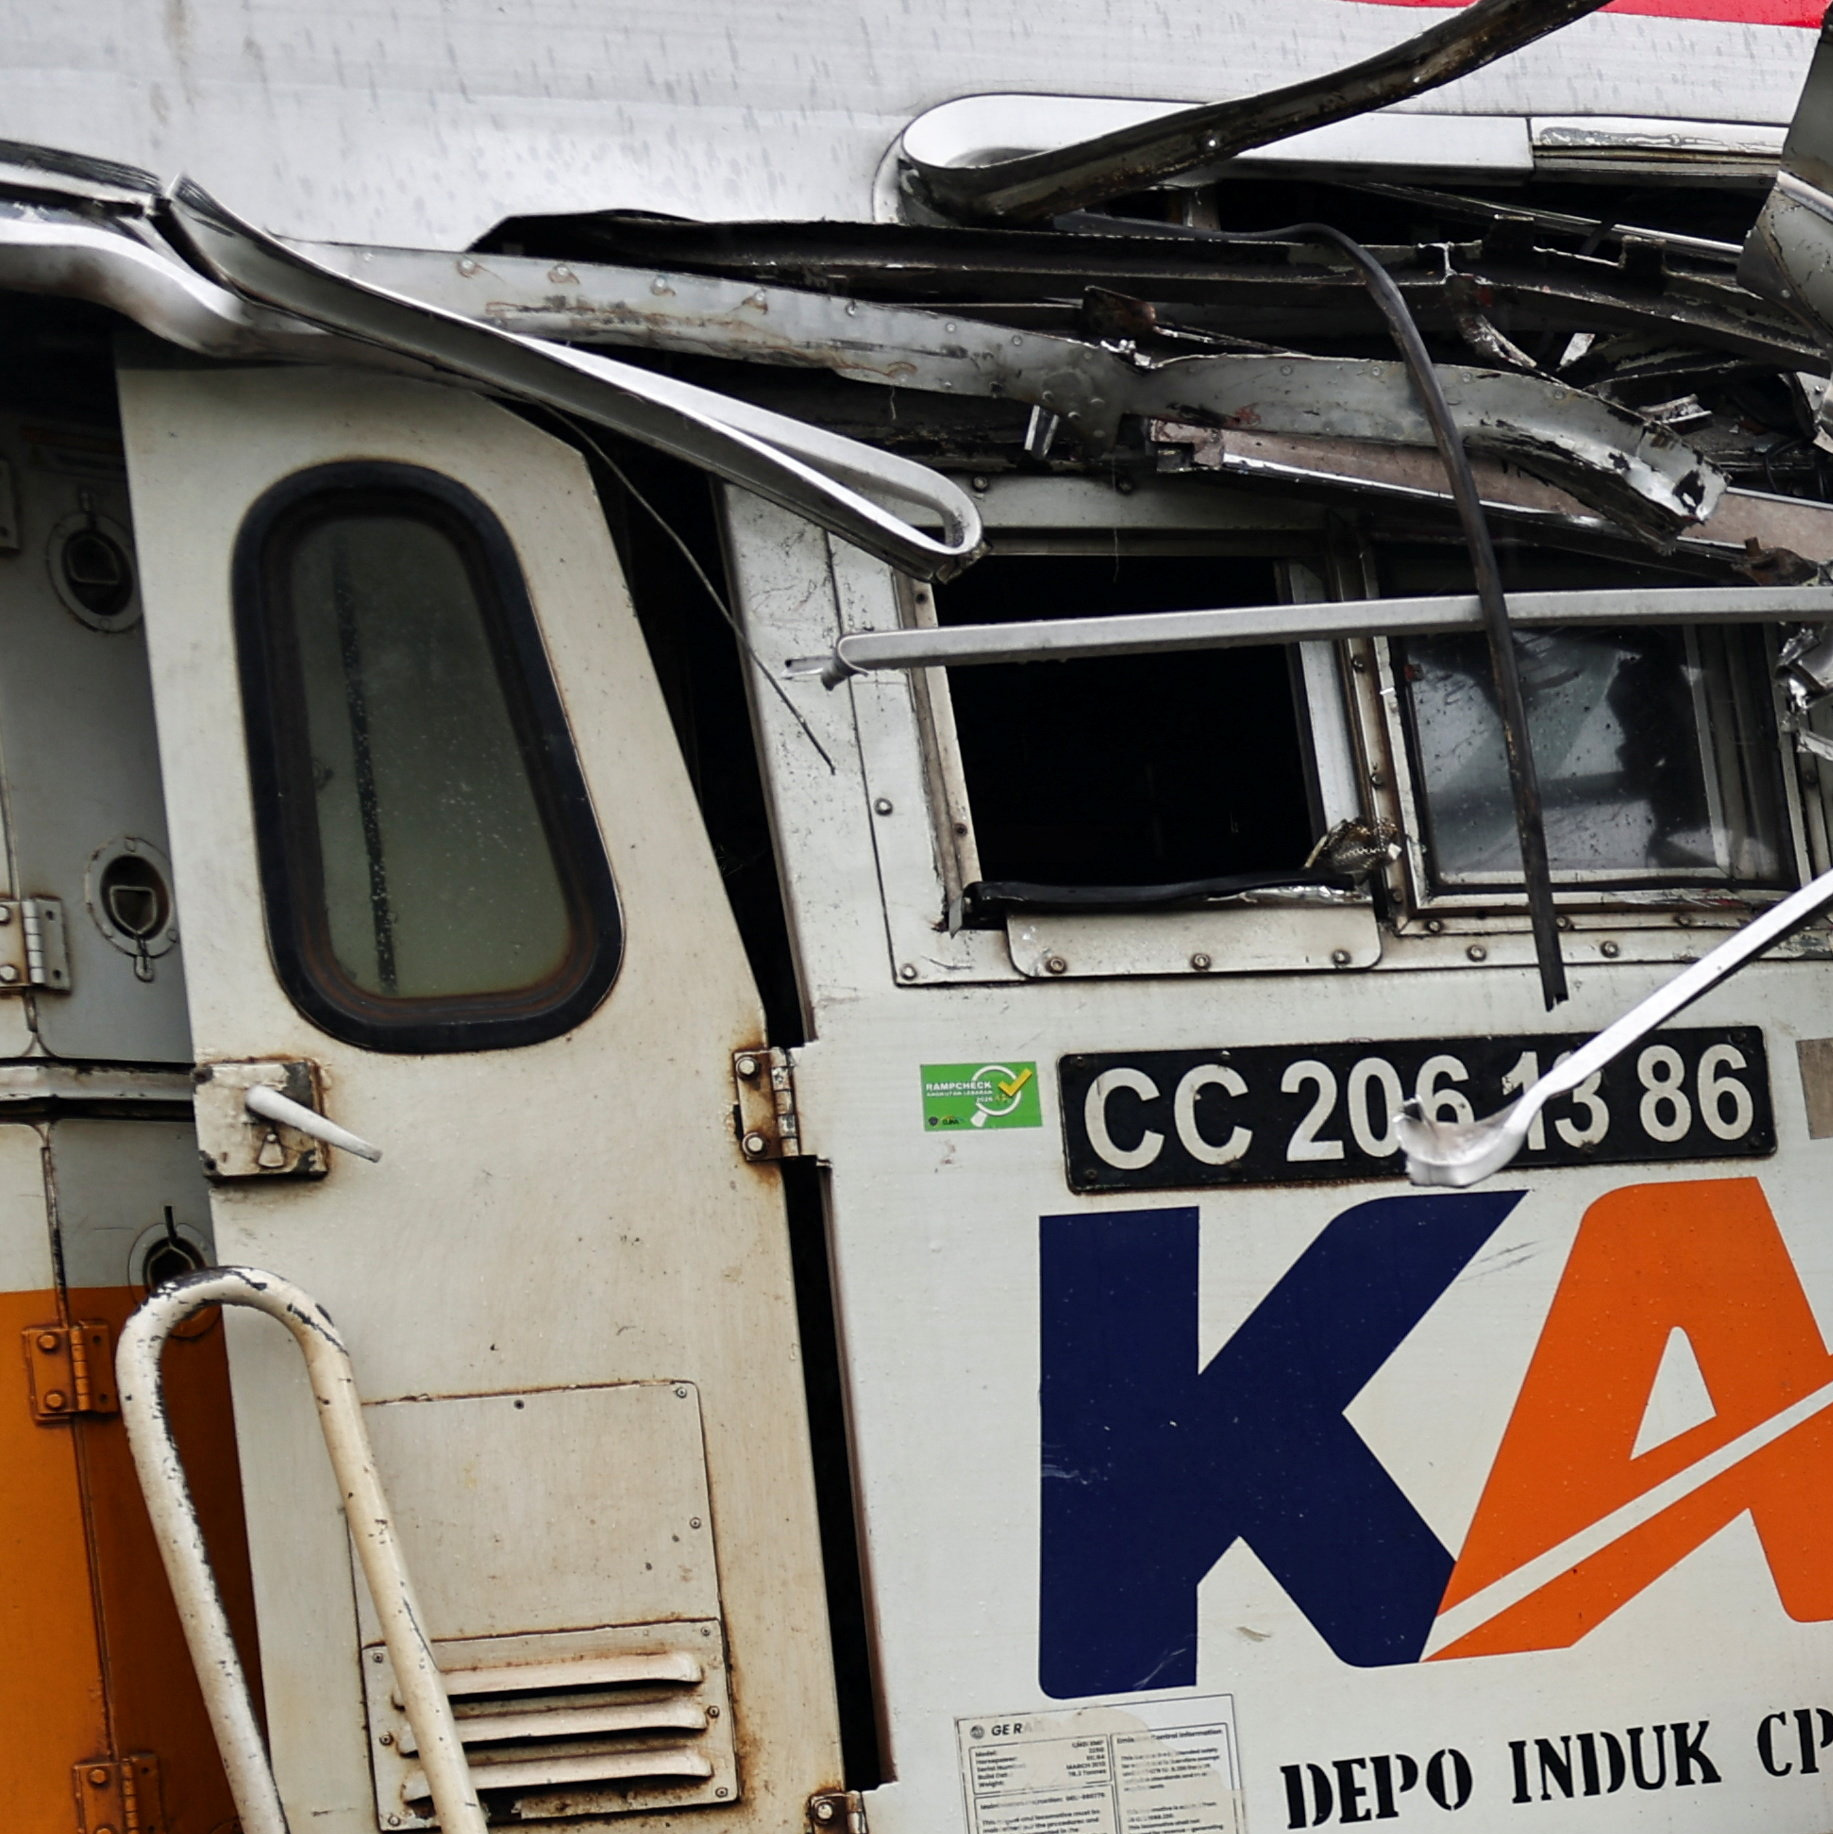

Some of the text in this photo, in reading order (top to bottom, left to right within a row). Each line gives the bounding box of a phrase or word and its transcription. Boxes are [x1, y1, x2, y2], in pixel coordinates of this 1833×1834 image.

[926, 1081, 992, 1091] RAMPCHECK
[1084, 1044, 1754, 1169] CC 206 13 86
[991, 1723, 1010, 1736] GE
[1280, 1748, 1473, 1829] DEPO
[1508, 1720, 1722, 1804] INDUK
